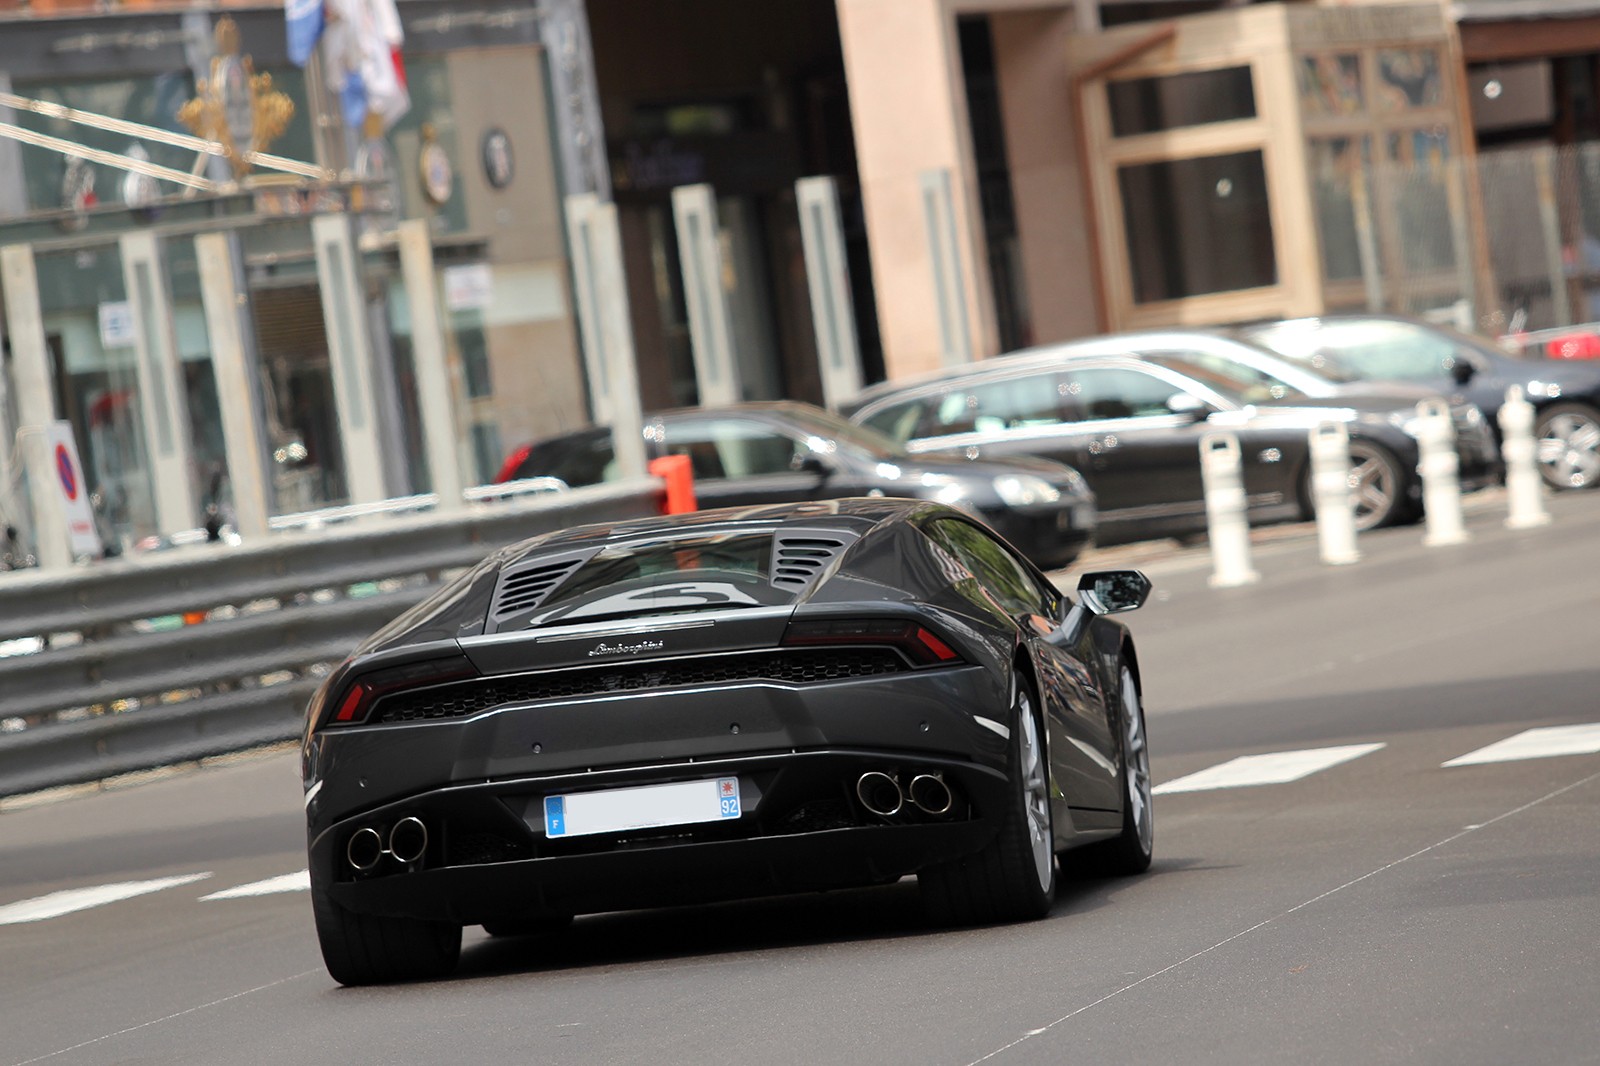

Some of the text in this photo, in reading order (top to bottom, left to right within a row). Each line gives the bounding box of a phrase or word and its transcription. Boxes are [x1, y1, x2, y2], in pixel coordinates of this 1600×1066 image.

[588, 640, 663, 656] Lamborghini
[722, 799, 738, 814] 92
[552, 819, 559, 829] F
